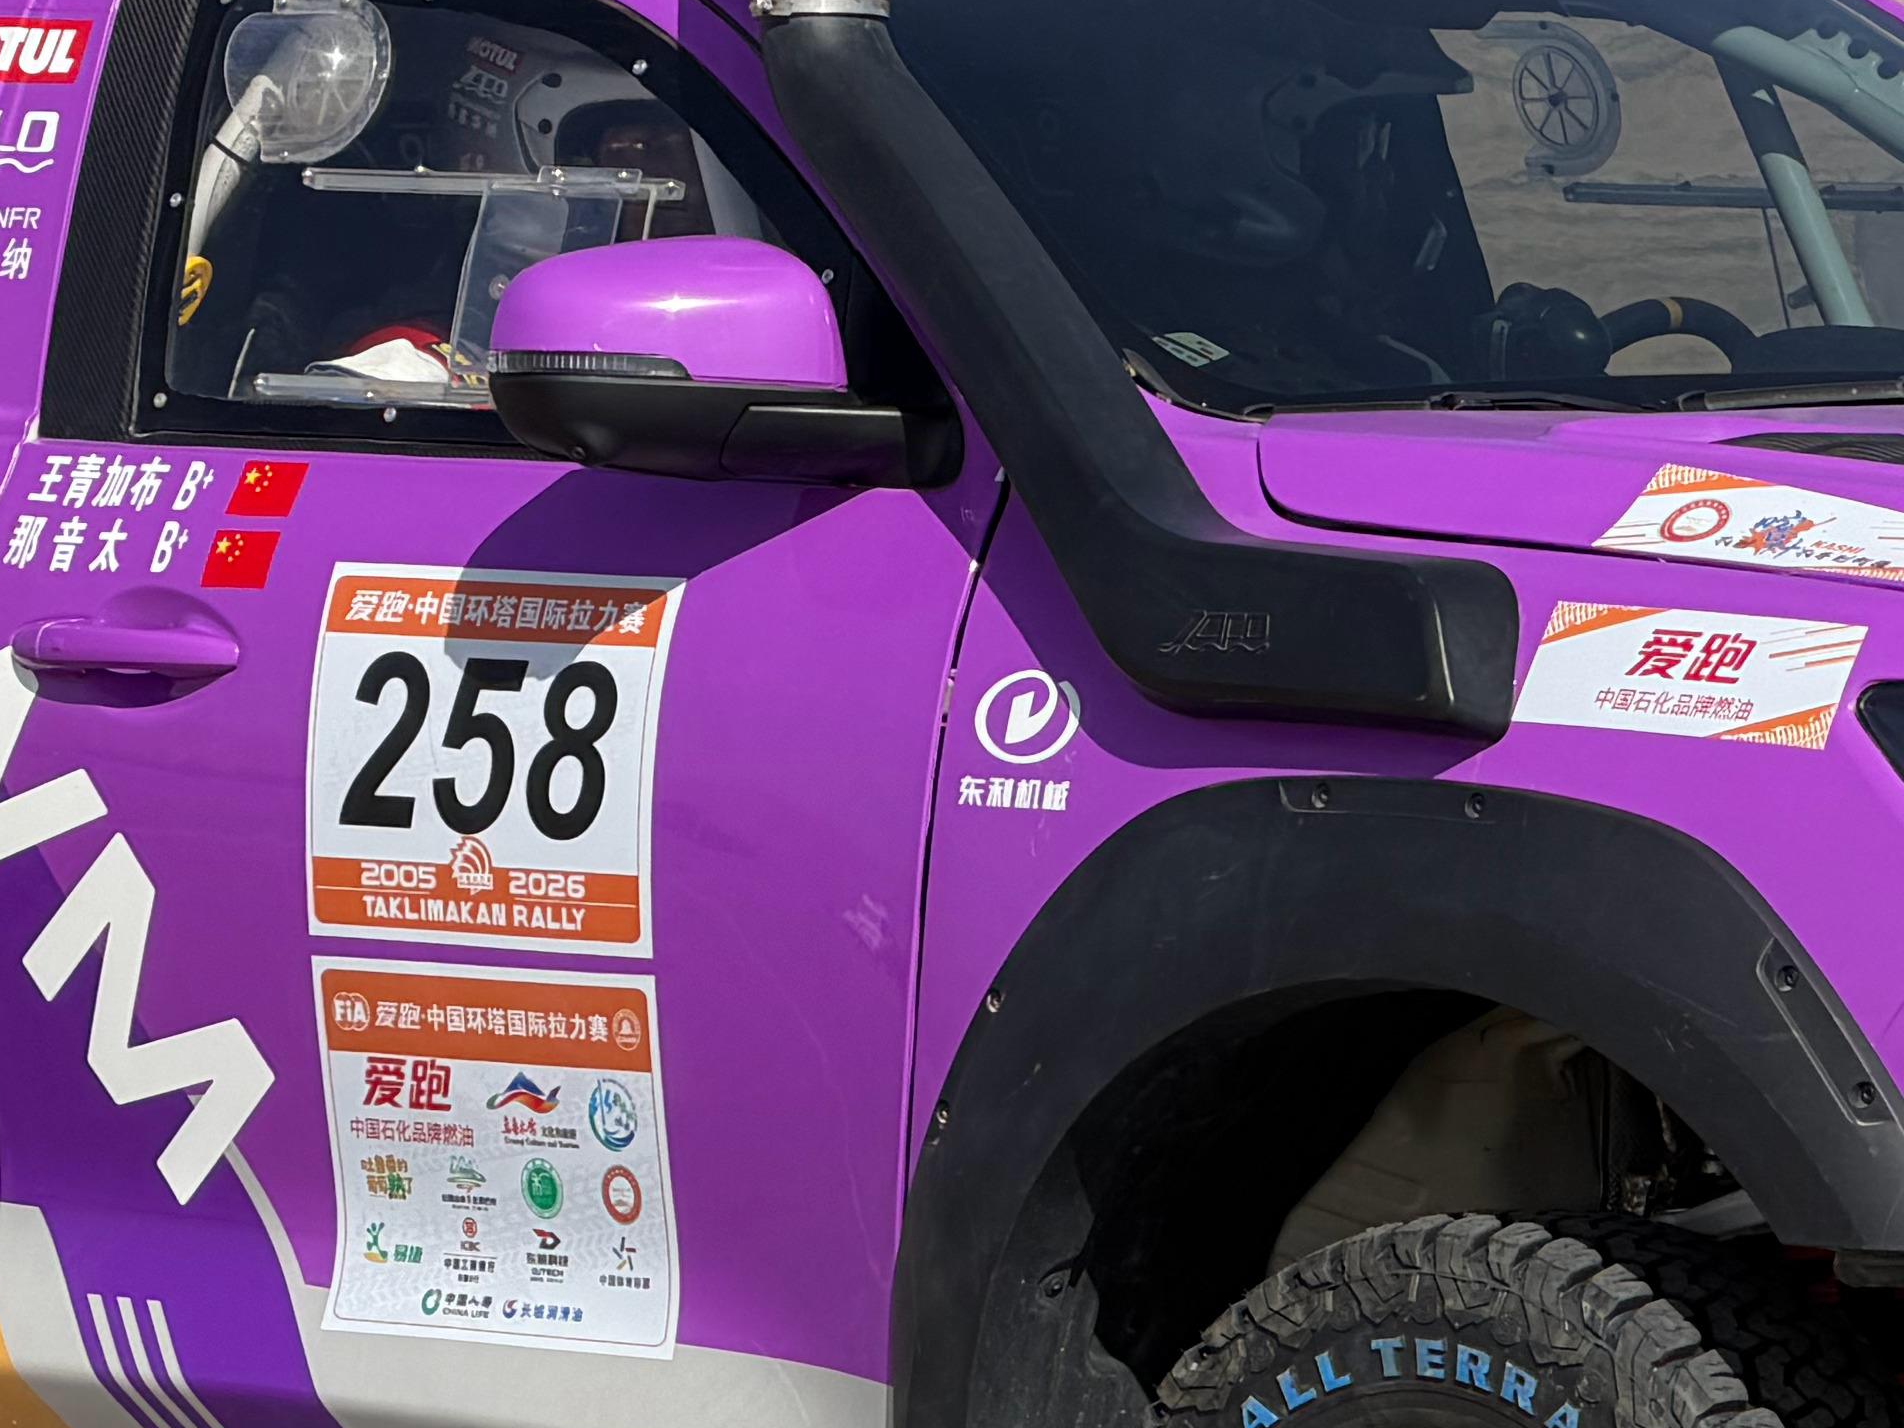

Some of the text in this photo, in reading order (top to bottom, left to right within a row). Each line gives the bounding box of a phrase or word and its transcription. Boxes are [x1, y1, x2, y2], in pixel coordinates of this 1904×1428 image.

[27, 453, 172, 512] 王青加布
[3, 515, 128, 573] 那音太
[345, 589, 648, 635] 爱跑·中国环塔国际拉力赛
[1624, 628, 1758, 685] 爱跑
[1595, 688, 1755, 722] 中国石化品牌燃油
[339, 650, 618, 841] 258
[957, 775, 1072, 811] 东利机械
[360, 861, 437, 889] 2005
[508, 871, 586, 898] 2026
[362, 895, 587, 932] TAKLIMAKAN RALLY
[375, 1001, 610, 1044] 爱跑·中国环塔国际拉力赛
[363, 1056, 452, 1113] 爱跑
[350, 1117, 475, 1149] 中国石化品牌燃油
